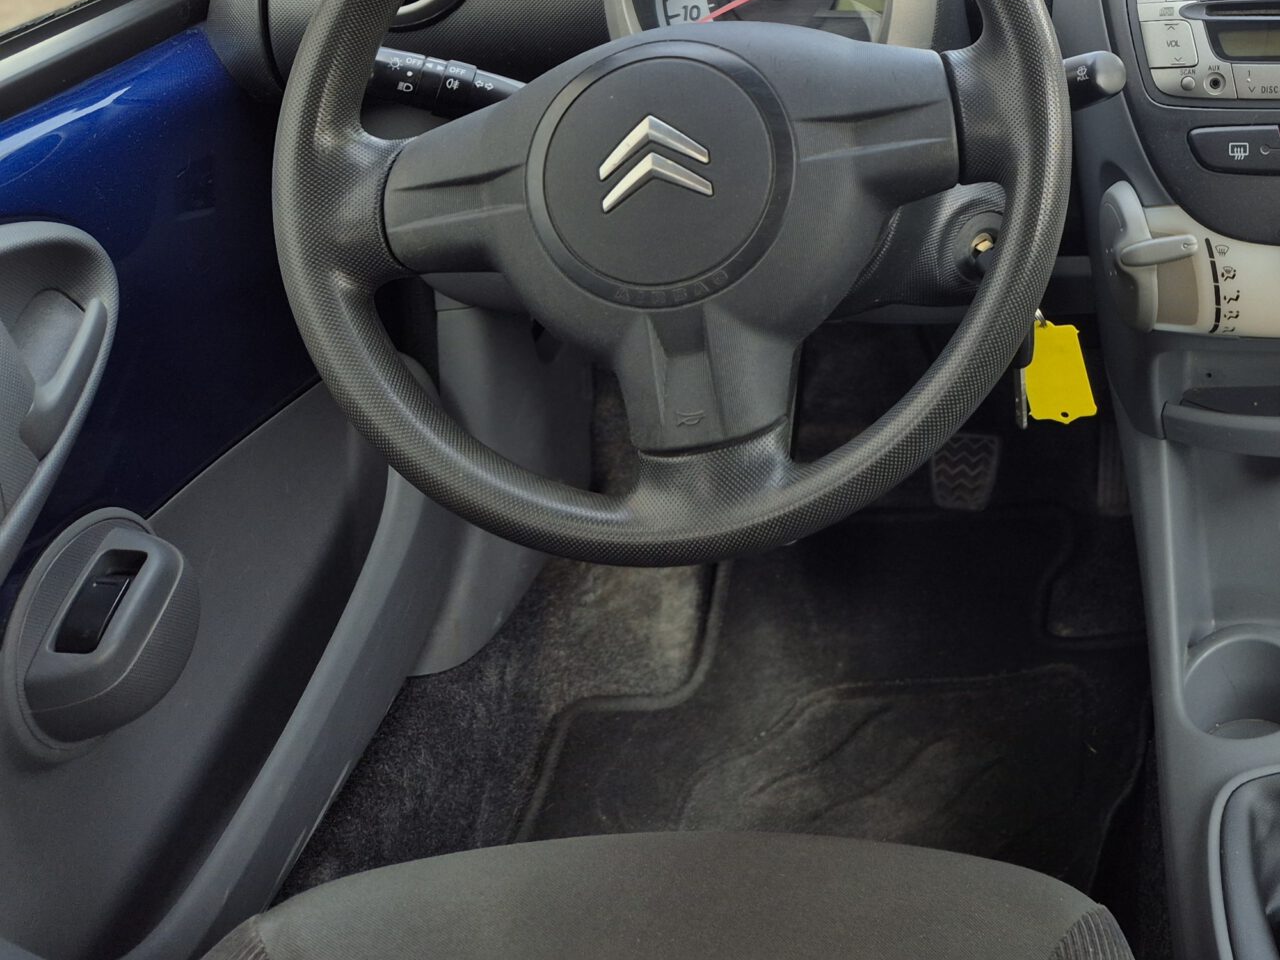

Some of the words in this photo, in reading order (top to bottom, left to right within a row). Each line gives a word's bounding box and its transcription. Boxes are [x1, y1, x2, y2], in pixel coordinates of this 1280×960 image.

[682, 5, 701, 21] 10
[1166, 40, 1180, 48] VOL
[405, 57, 422, 67] OFF
[449, 66, 466, 76] OFF
